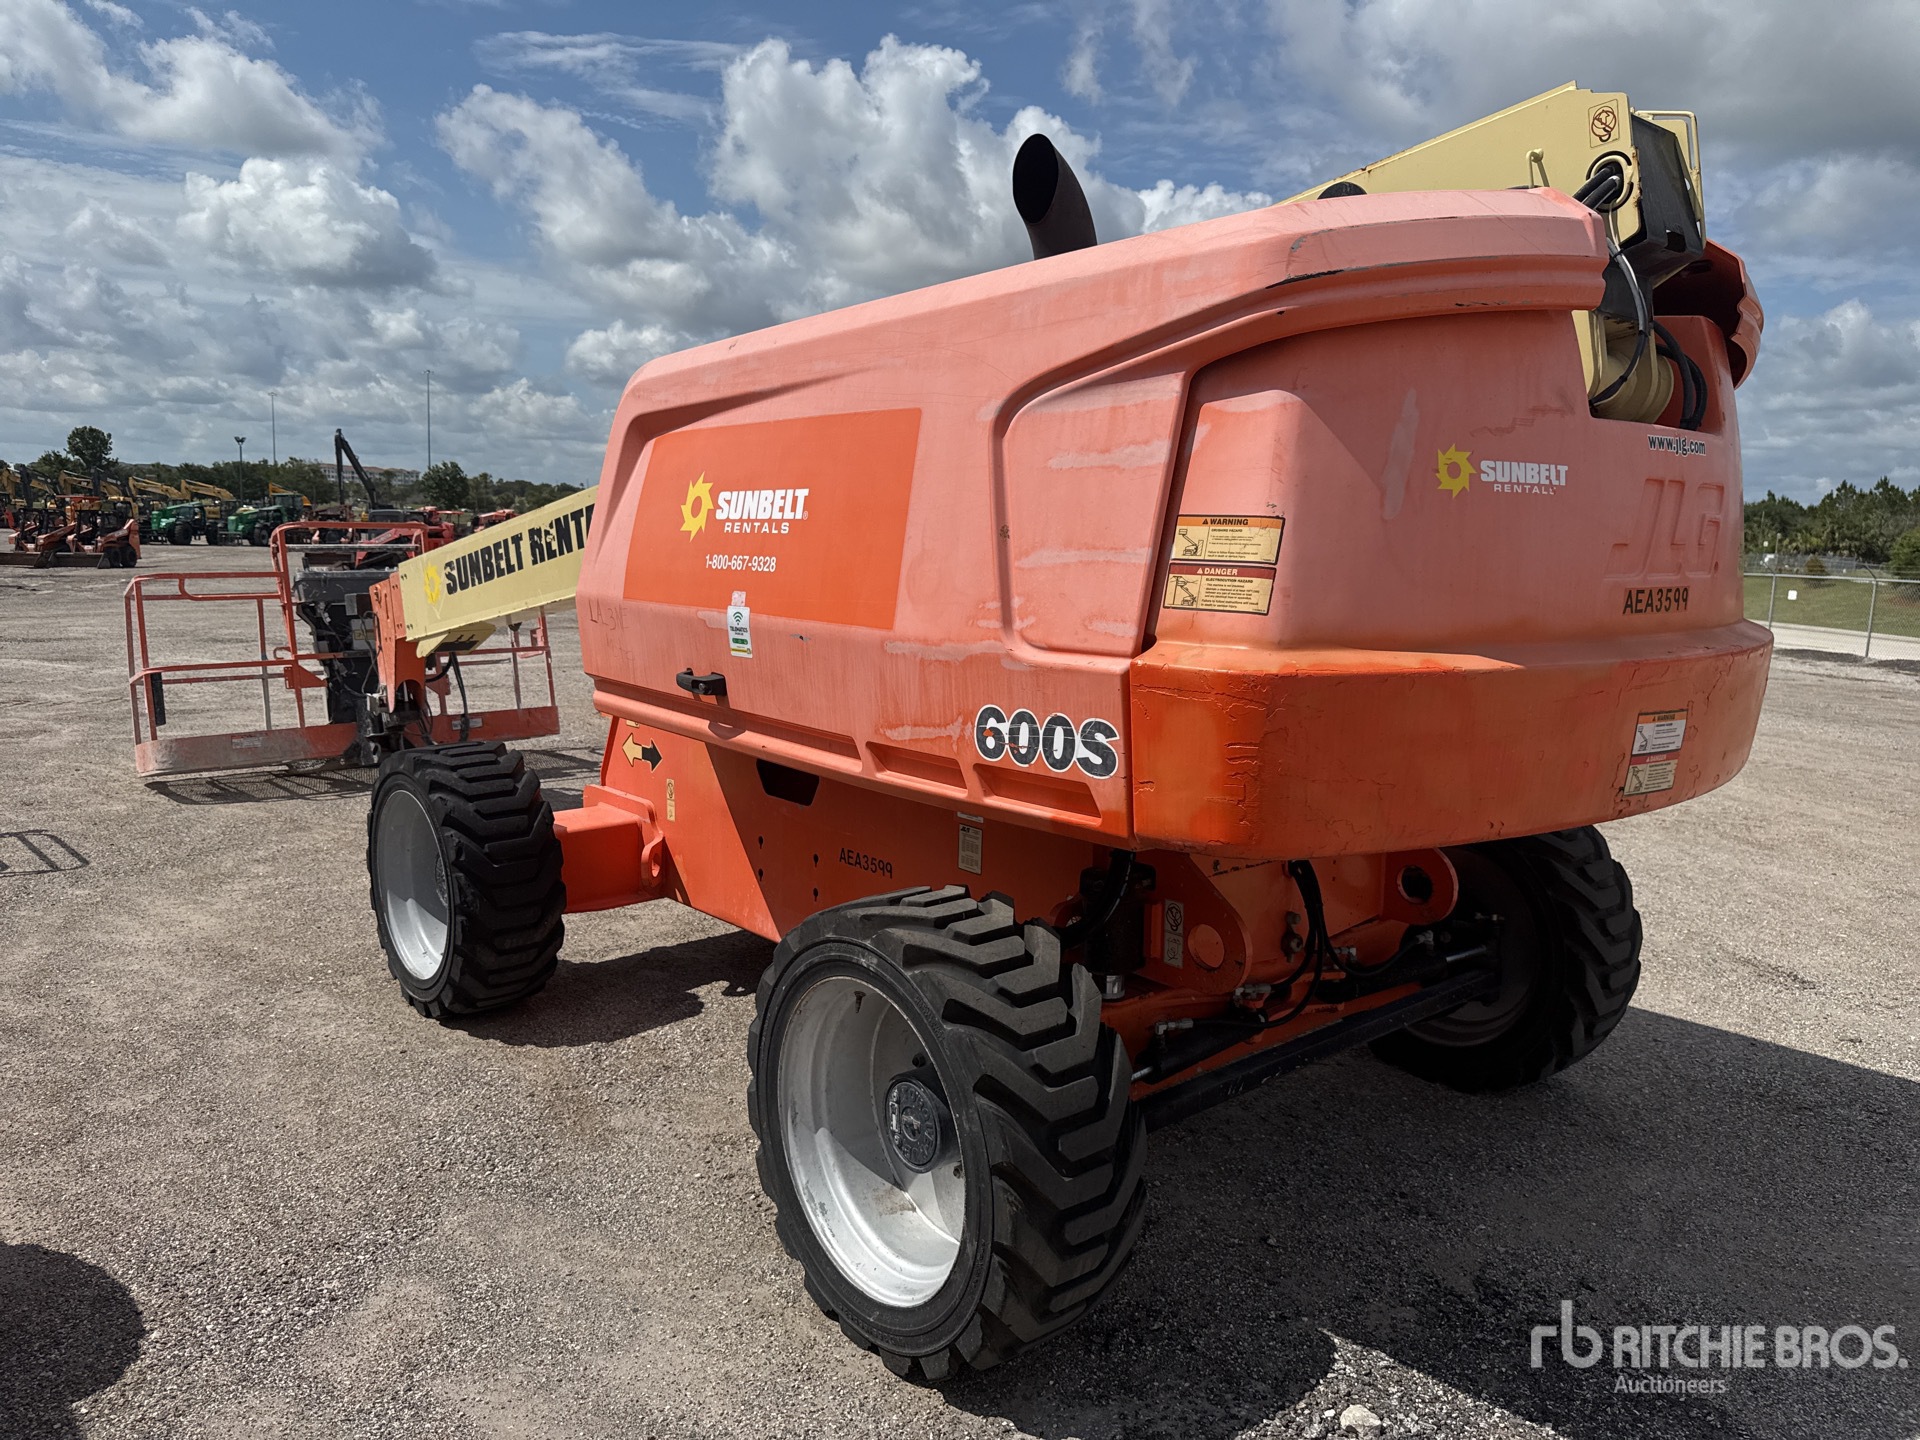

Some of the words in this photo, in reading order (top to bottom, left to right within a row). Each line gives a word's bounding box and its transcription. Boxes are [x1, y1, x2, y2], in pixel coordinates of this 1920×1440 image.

[1648, 434, 1706, 456] www.jlg.com
[1480, 460, 1568, 485] SUNBELT
[715, 488, 809, 520] SUNBELT
[724, 522, 790, 535] RENTALS
[1210, 518, 1249, 526] WARNING
[444, 532, 524, 595] SUNBELT
[705, 554, 777, 573] 1-800-667-9328
[1204, 568, 1238, 576] DANGER
[1623, 586, 1689, 614] AEA3599
[974, 704, 1119, 779] 600S
[839, 848, 893, 879] AEA3599
